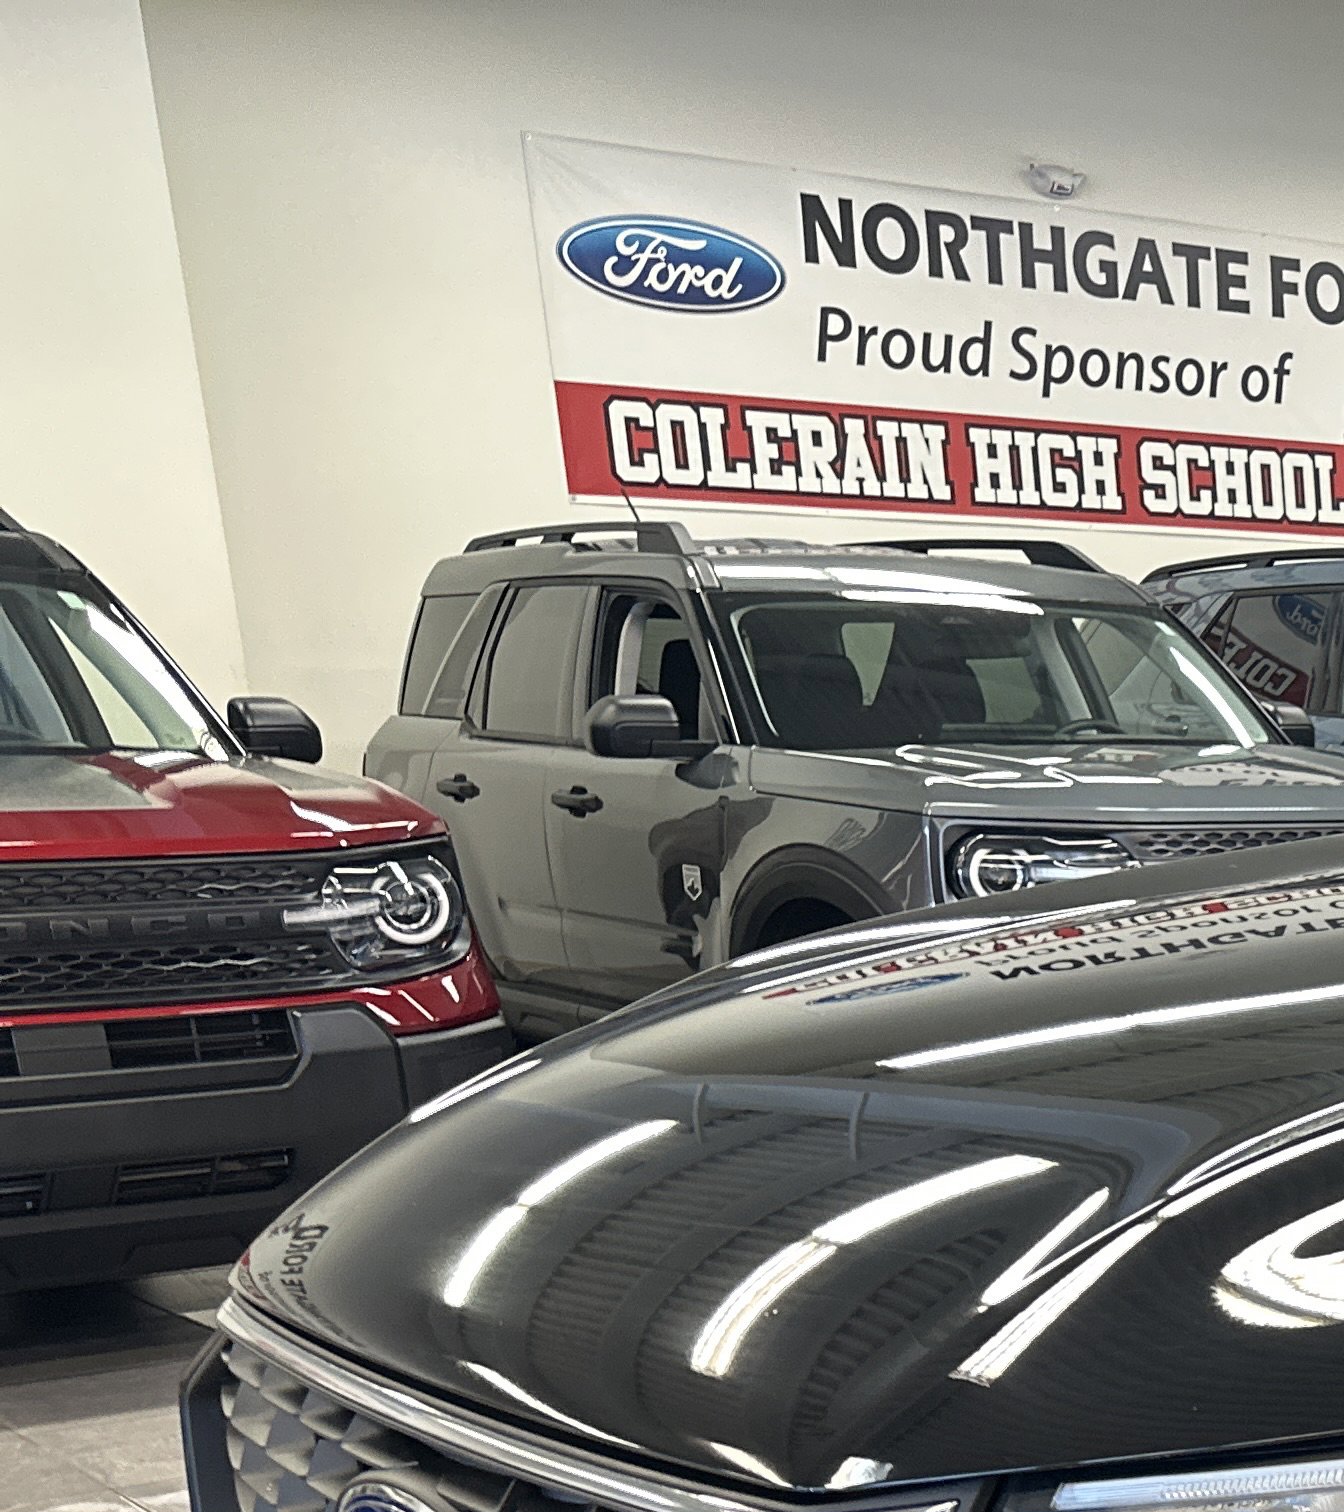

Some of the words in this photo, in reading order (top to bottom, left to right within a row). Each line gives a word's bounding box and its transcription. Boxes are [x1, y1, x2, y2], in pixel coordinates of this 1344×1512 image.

[603, 227, 743, 302] Ford
[800, 192, 1251, 315] NORTHGATE
[816, 307, 992, 377] Proud
[1009, 325, 1228, 400] Sponsor
[1241, 352, 1293, 405] of
[604, 394, 954, 507] COLERAIN
[968, 428, 1123, 513] HIGH
